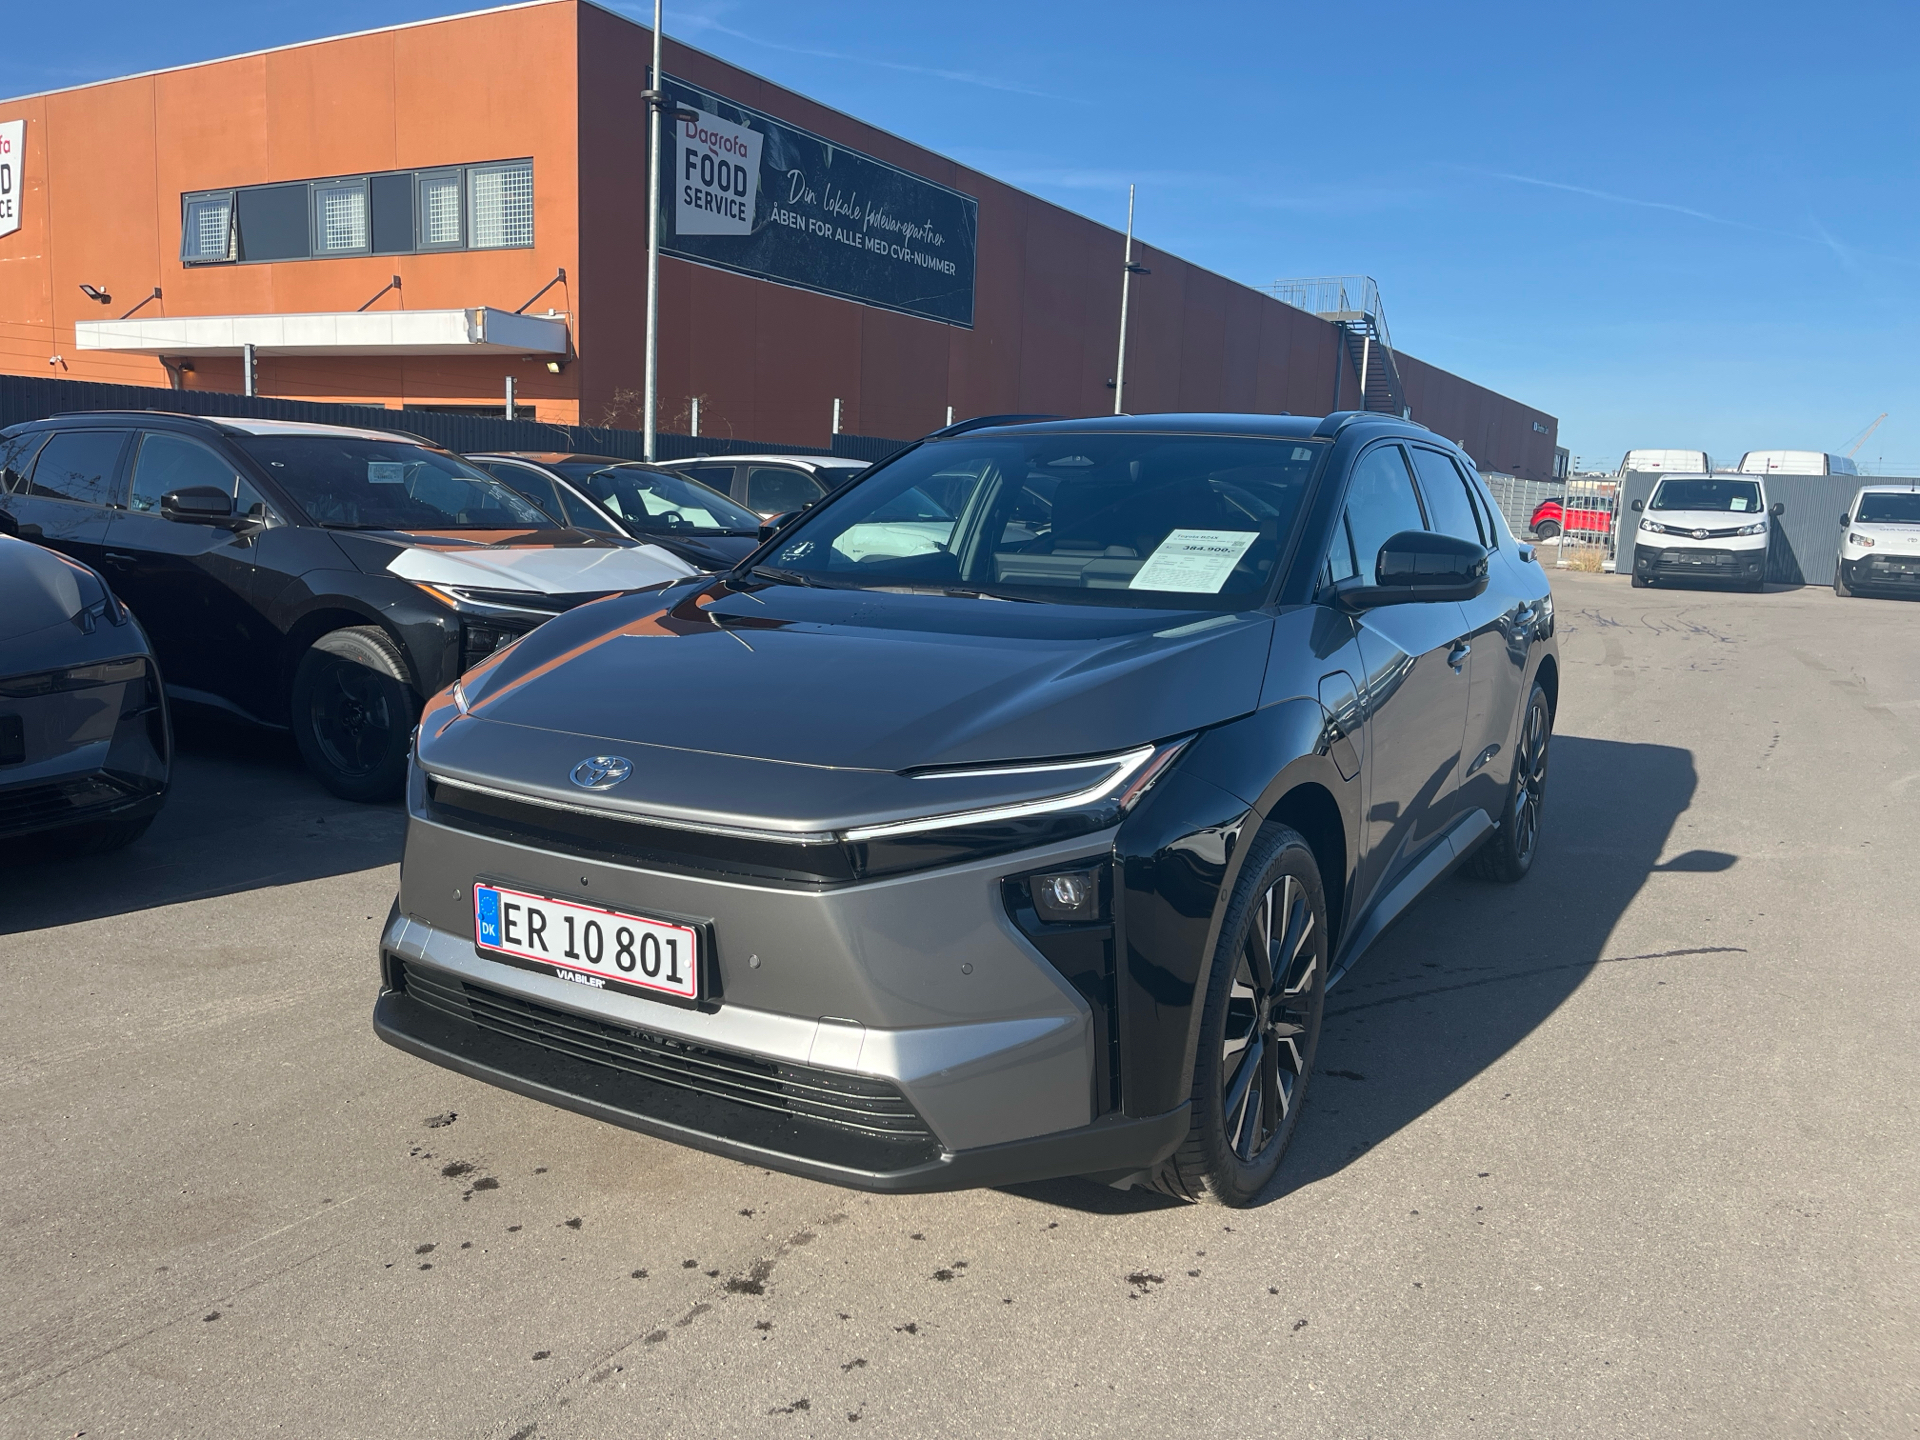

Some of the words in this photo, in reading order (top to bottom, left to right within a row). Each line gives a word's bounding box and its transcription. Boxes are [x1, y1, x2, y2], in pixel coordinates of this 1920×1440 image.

[685, 121, 748, 158] Dagrofa
[685, 147, 747, 198] FOOD
[683, 185, 747, 222] SERVICE
[787, 169, 817, 205] Din
[823, 182, 862, 220] lokale
[863, 200, 946, 248] fødevarepartner
[770, 201, 806, 231] ÅBEN
[809, 218, 833, 239] FOR
[834, 227, 863, 248] ALLE
[865, 235, 889, 255] MED
[890, 244, 956, 276] CVR-NUMMER
[482, 921, 496, 937] DK
[503, 902, 549, 952] ER
[563, 915, 604, 964] 10
[615, 926, 683, 984] 801
